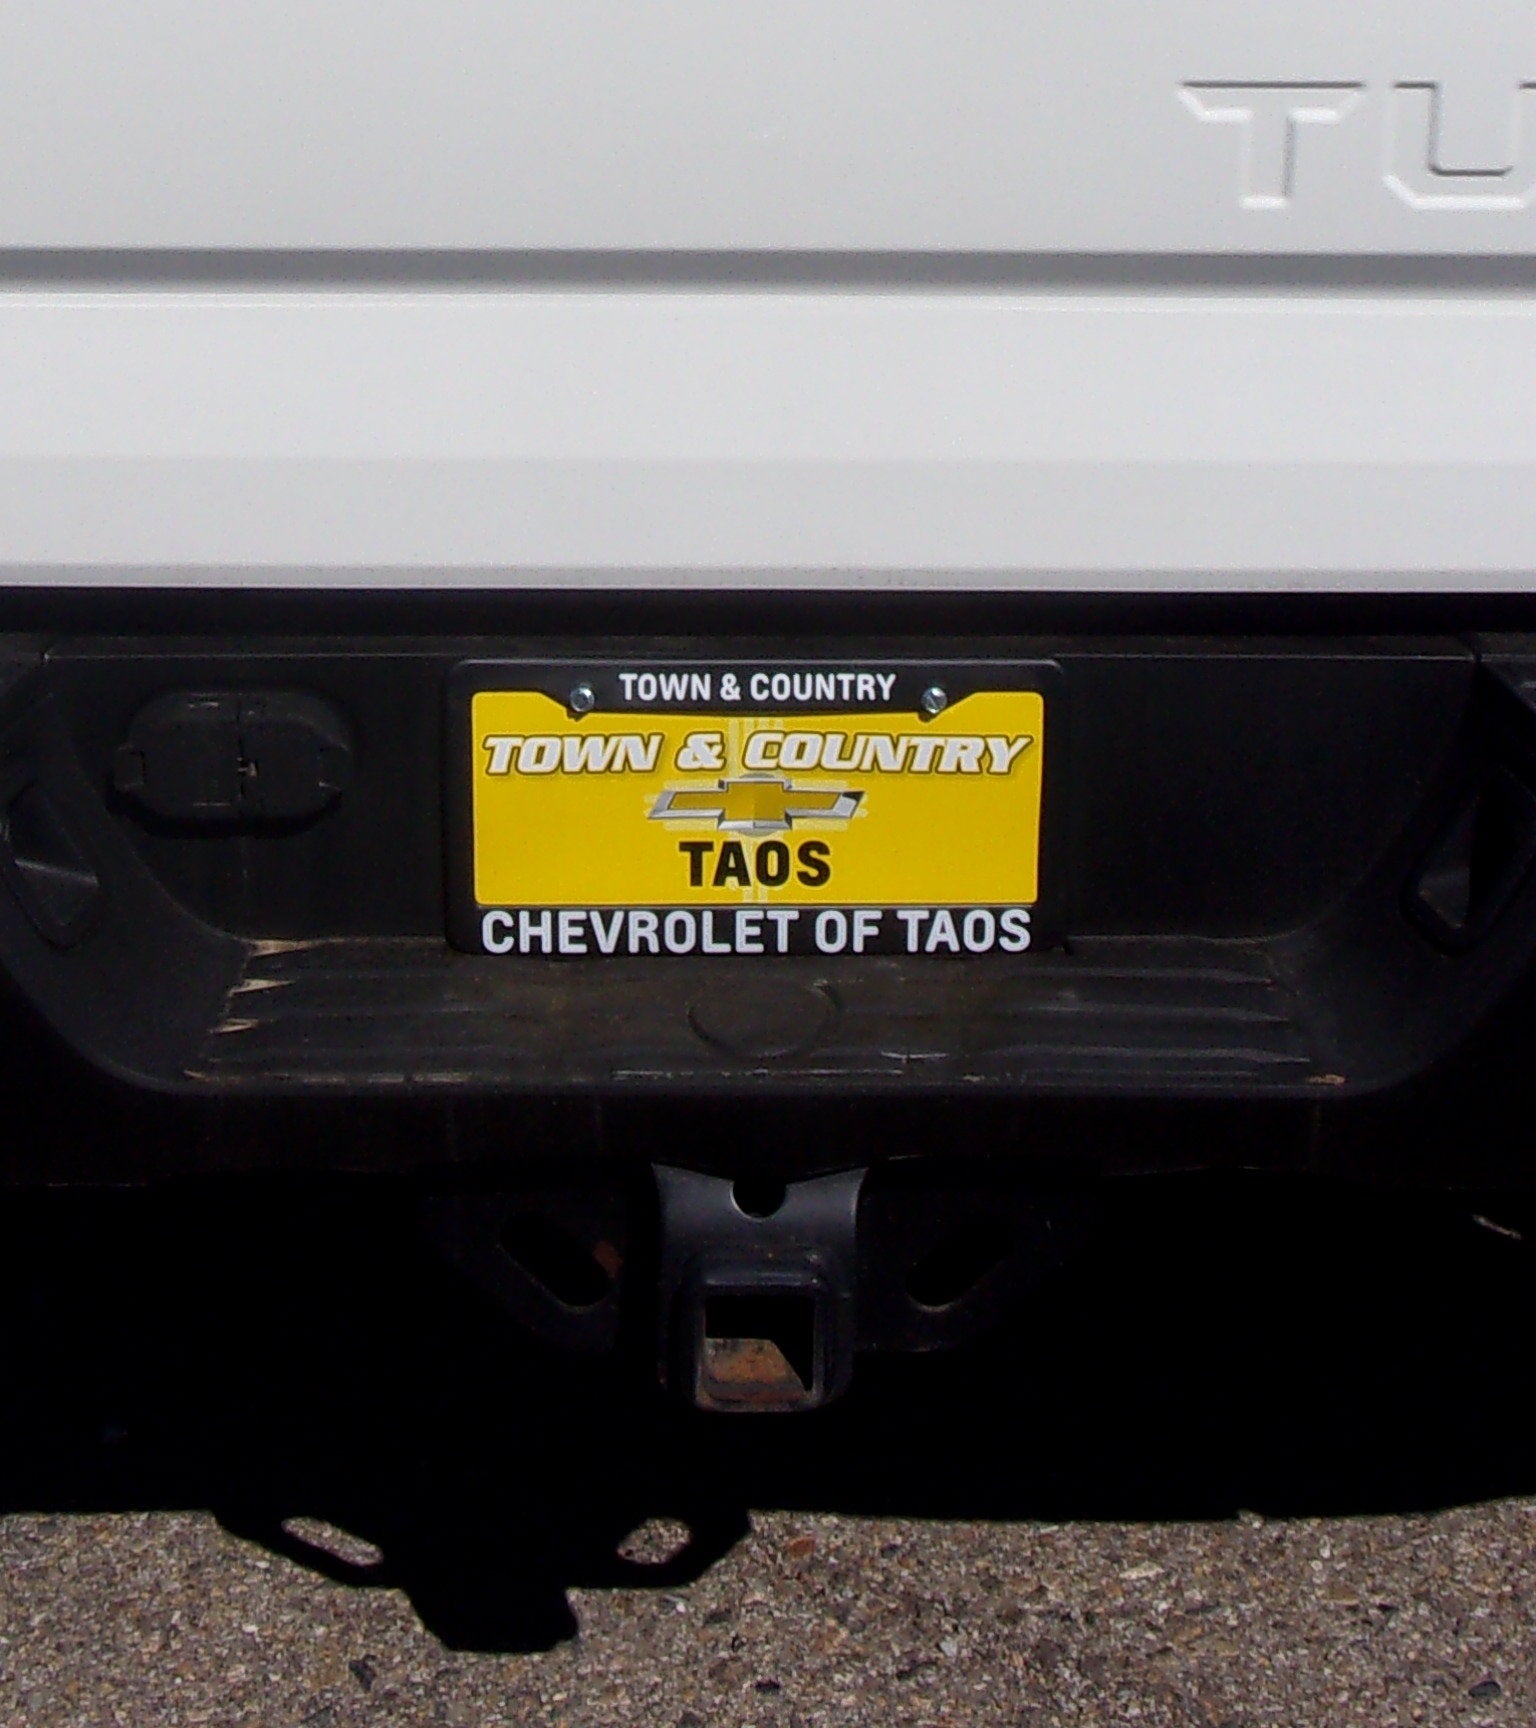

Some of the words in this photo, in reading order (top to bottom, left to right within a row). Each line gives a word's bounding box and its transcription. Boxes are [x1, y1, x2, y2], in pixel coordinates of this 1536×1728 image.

[618, 672, 715, 701] TOWN
[719, 672, 742, 700] &
[749, 672, 897, 701] COUNTRY
[482, 731, 664, 775] TOWN
[675, 730, 727, 771] &
[742, 729, 1034, 776] COUNTRY
[678, 840, 832, 888] TAOS
[481, 910, 800, 954] CHEVROLET
[814, 910, 886, 954] OF
[896, 909, 1032, 953] TAOS
